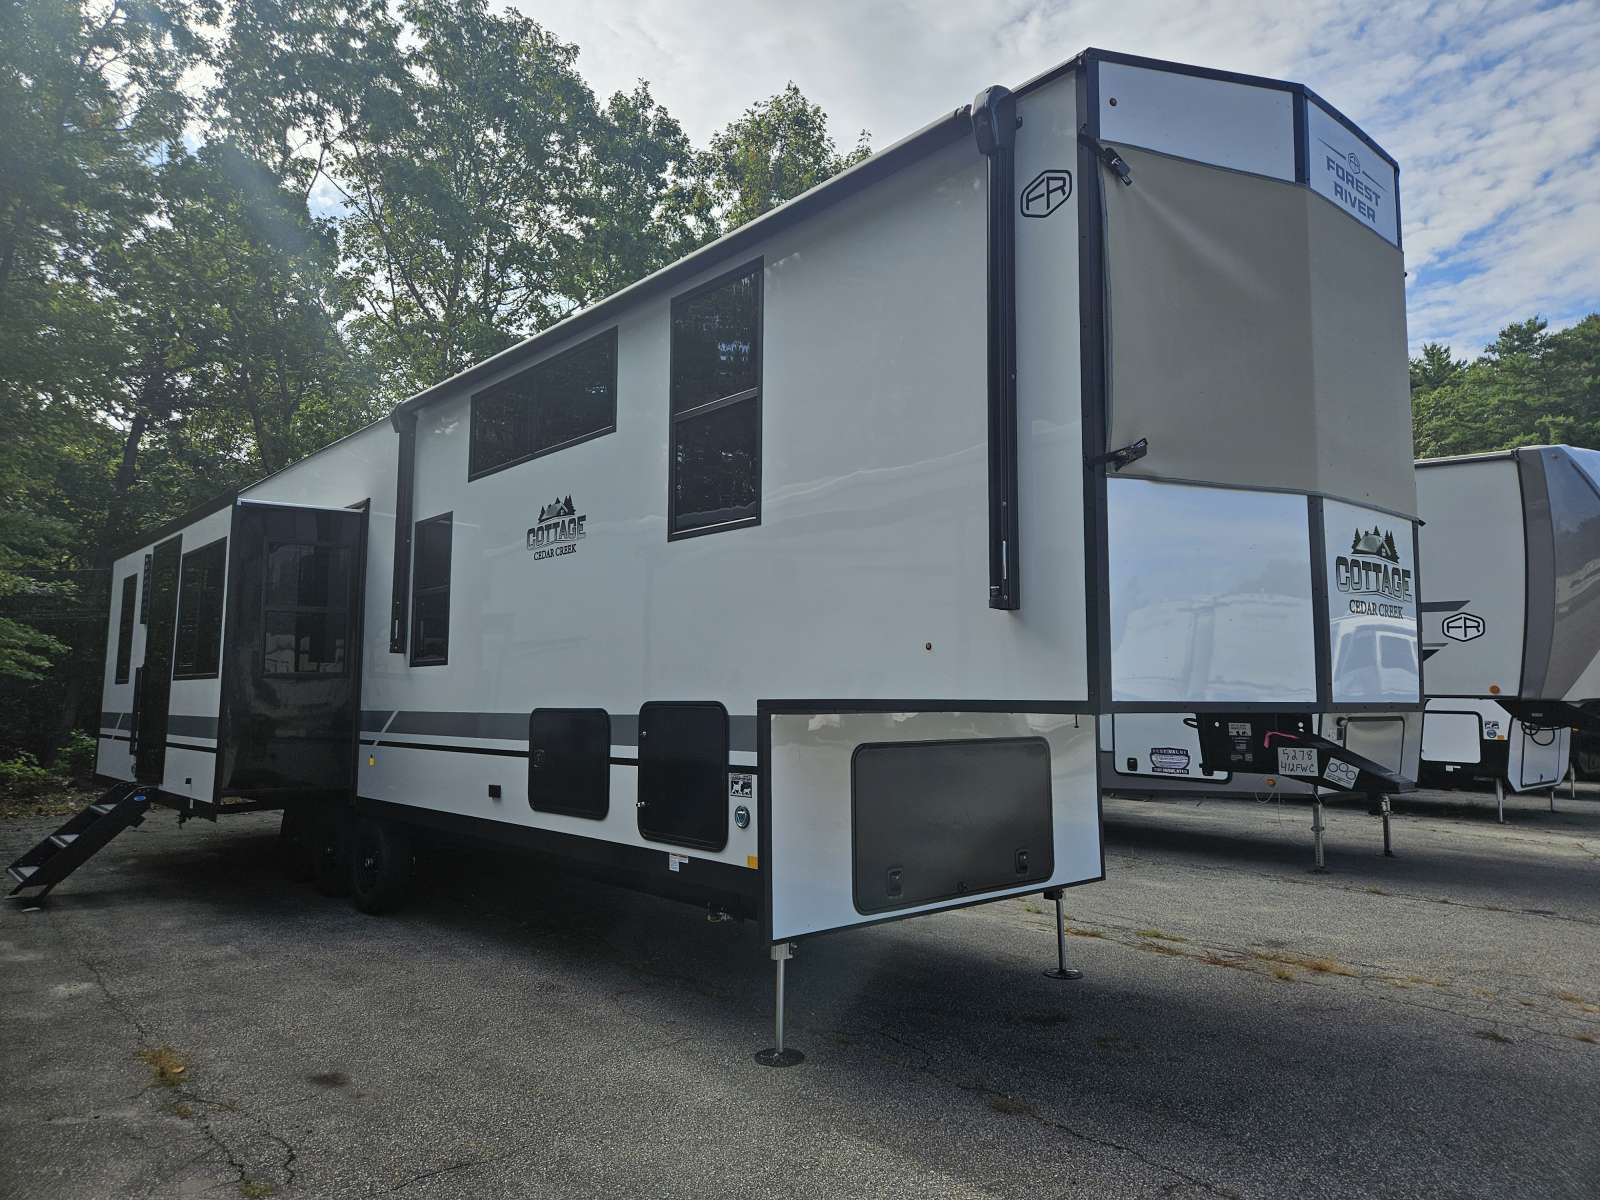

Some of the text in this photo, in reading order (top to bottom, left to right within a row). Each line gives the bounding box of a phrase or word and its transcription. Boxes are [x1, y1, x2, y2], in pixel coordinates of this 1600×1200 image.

[1326, 155, 1381, 207] FOREST
[1333, 181, 1376, 224] RIVER
[527, 515, 586, 551] COTTAGE
[533, 544, 577, 560] CEDAR CREEK
[1336, 556, 1412, 601] COTTAGE
[1349, 599, 1404, 619] CEDAR CREEK
[1280, 761, 1315, 773] 412FWC
[1283, 749, 1313, 760] 5278
